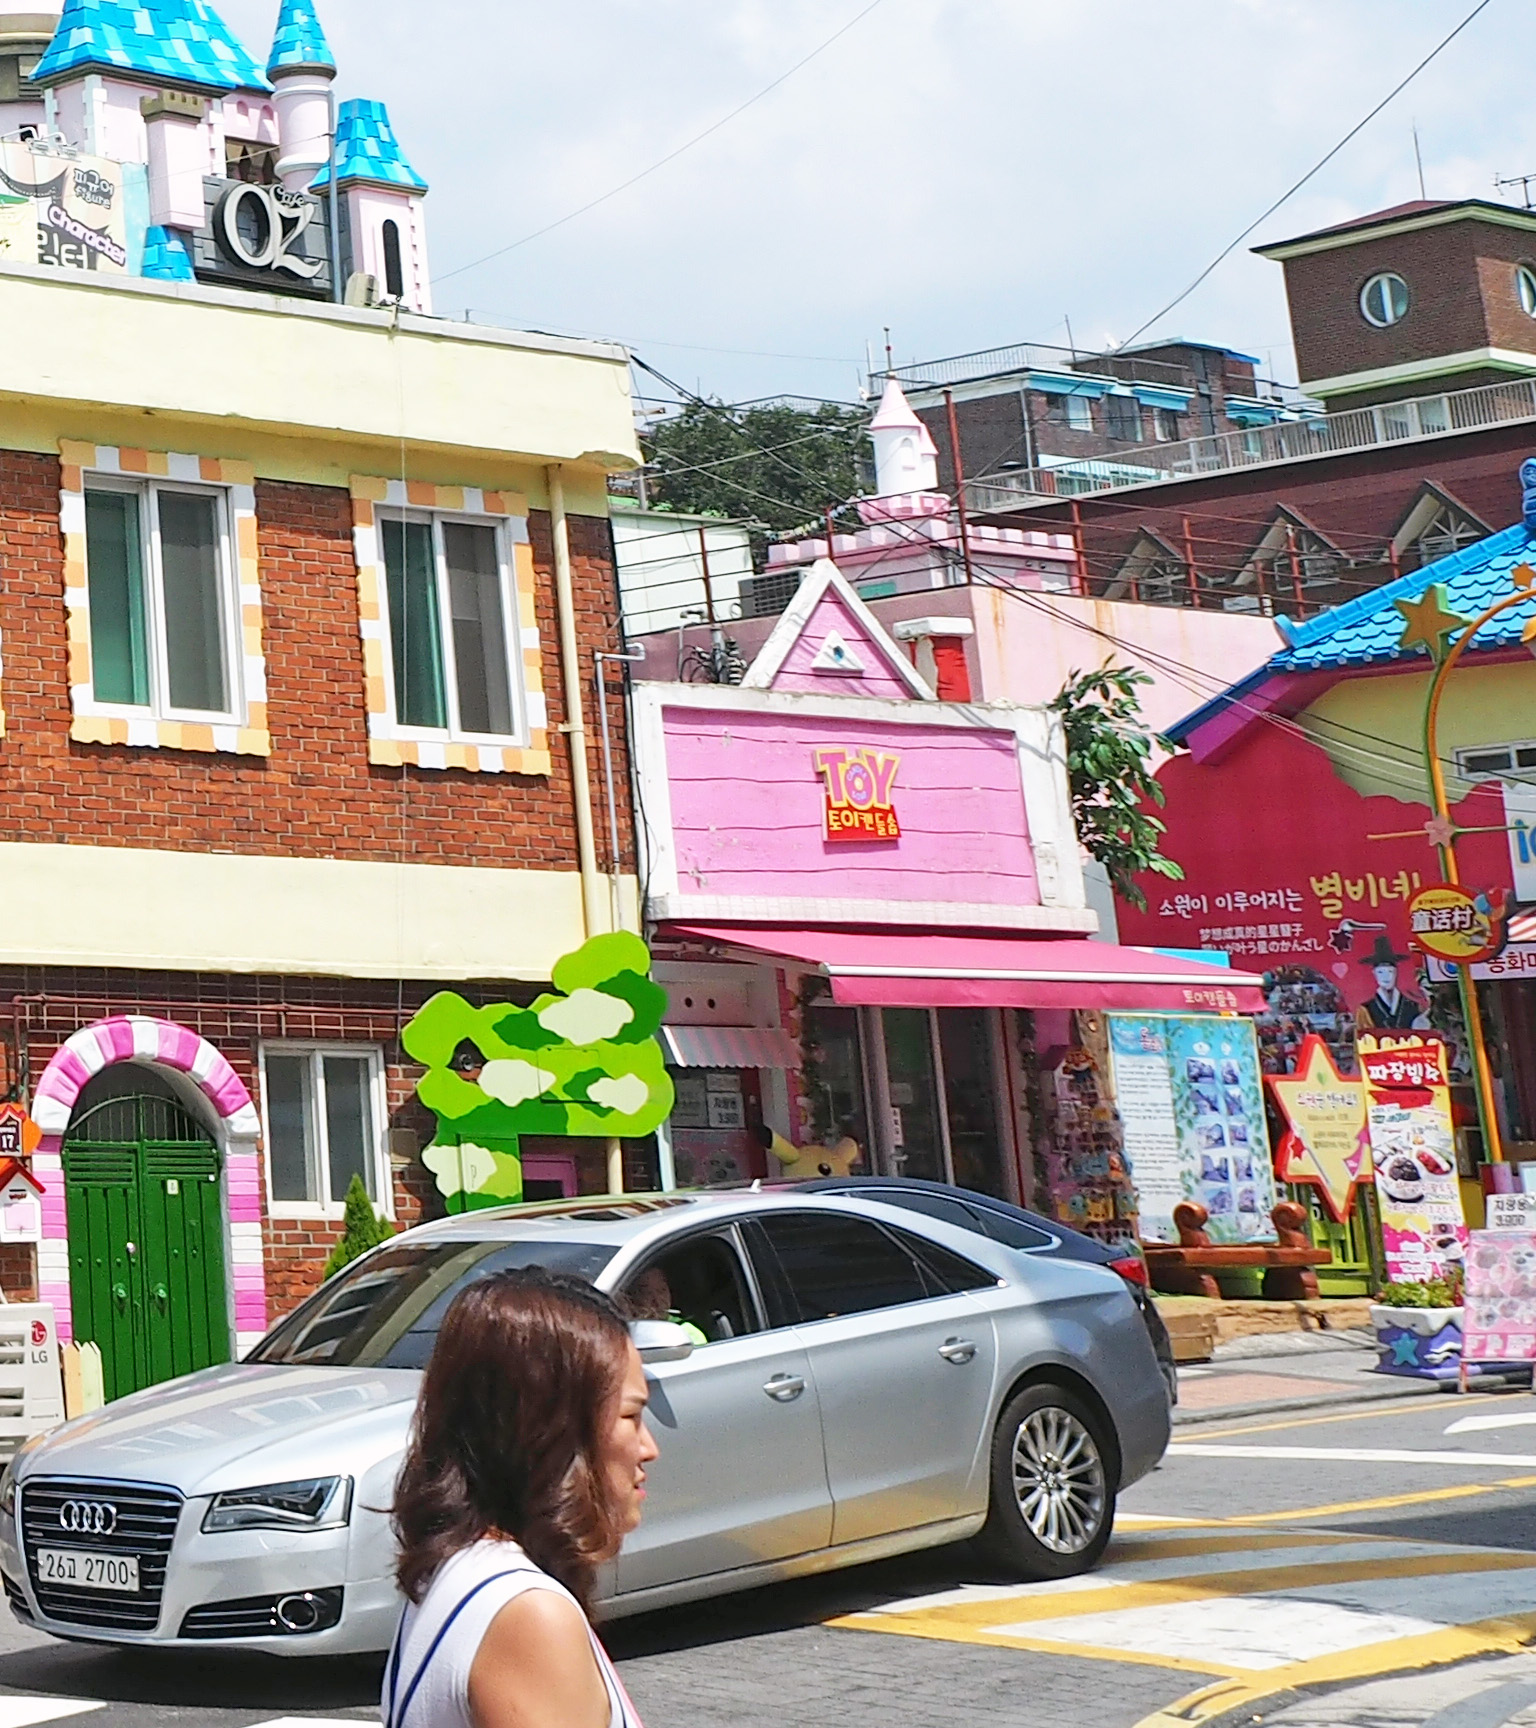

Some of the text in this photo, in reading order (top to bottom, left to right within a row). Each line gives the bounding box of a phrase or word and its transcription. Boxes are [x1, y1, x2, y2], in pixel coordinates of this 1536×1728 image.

[74, 168, 114, 196] 피규어
[47, 203, 128, 267] Character
[814, 747, 901, 810] TOY
[1159, 893, 1209, 919] 소원이
[1215, 888, 1304, 913] 이루어지는
[1411, 906, 1475, 933] 童话村
[1, 1134, 15, 1148] 17
[31, 1350, 48, 1364] LG
[46, 1553, 129, 1585] 26고 2700
